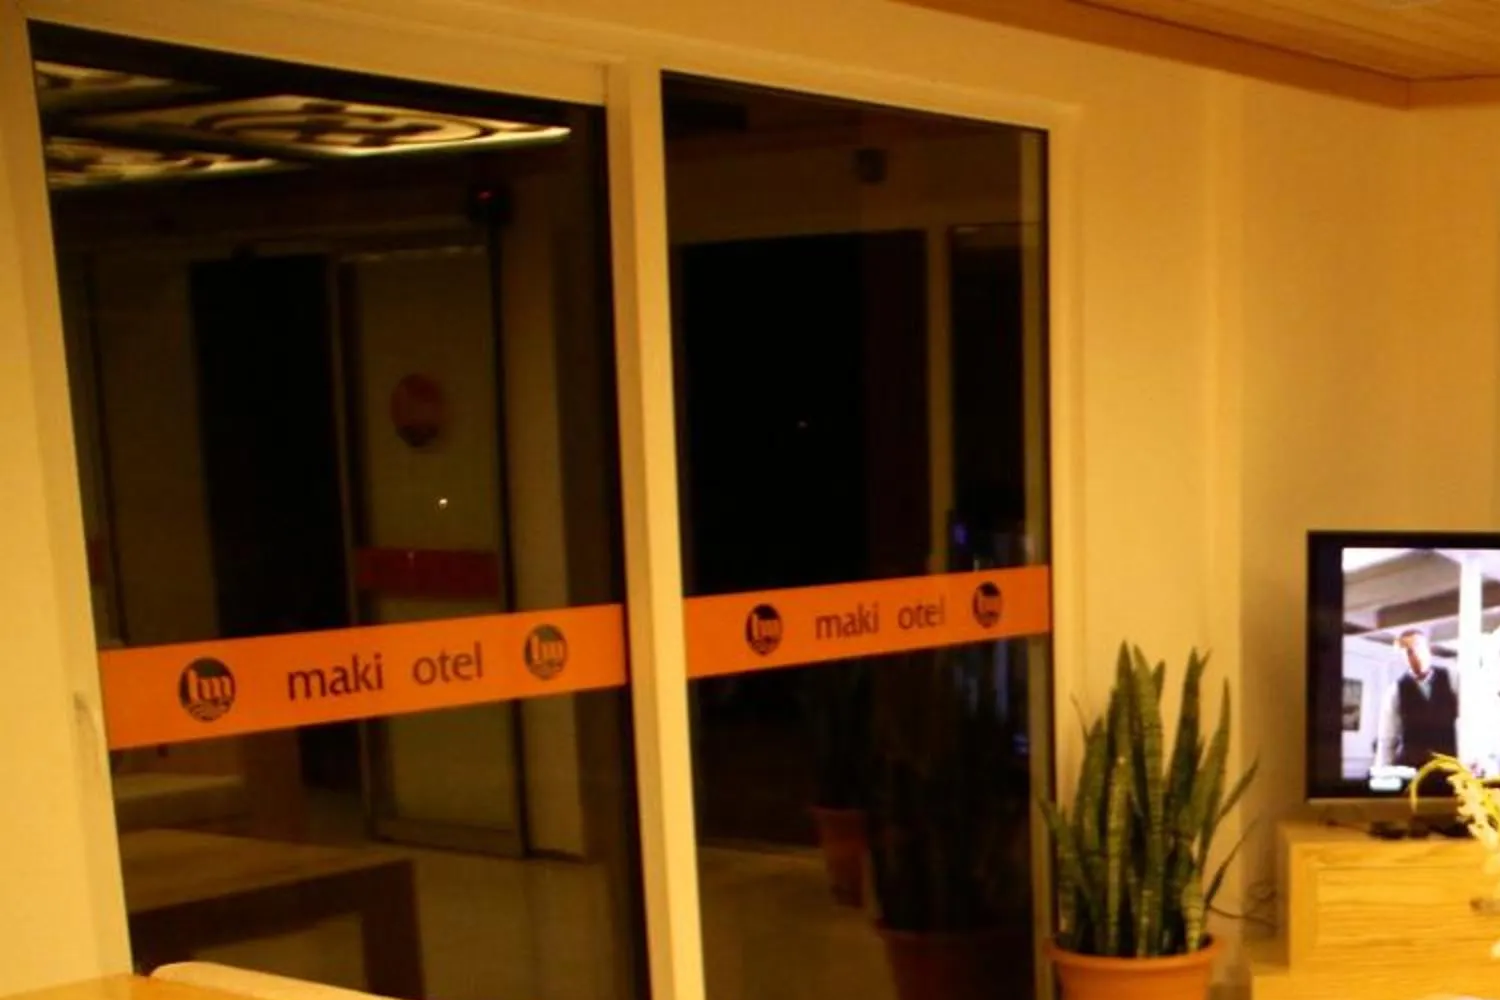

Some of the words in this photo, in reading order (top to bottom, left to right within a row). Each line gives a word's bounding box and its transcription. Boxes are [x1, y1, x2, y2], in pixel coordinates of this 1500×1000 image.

[815, 602, 880, 640] maki
[898, 595, 946, 630] otel
[287, 652, 384, 701] maki
[412, 641, 484, 686] otel
